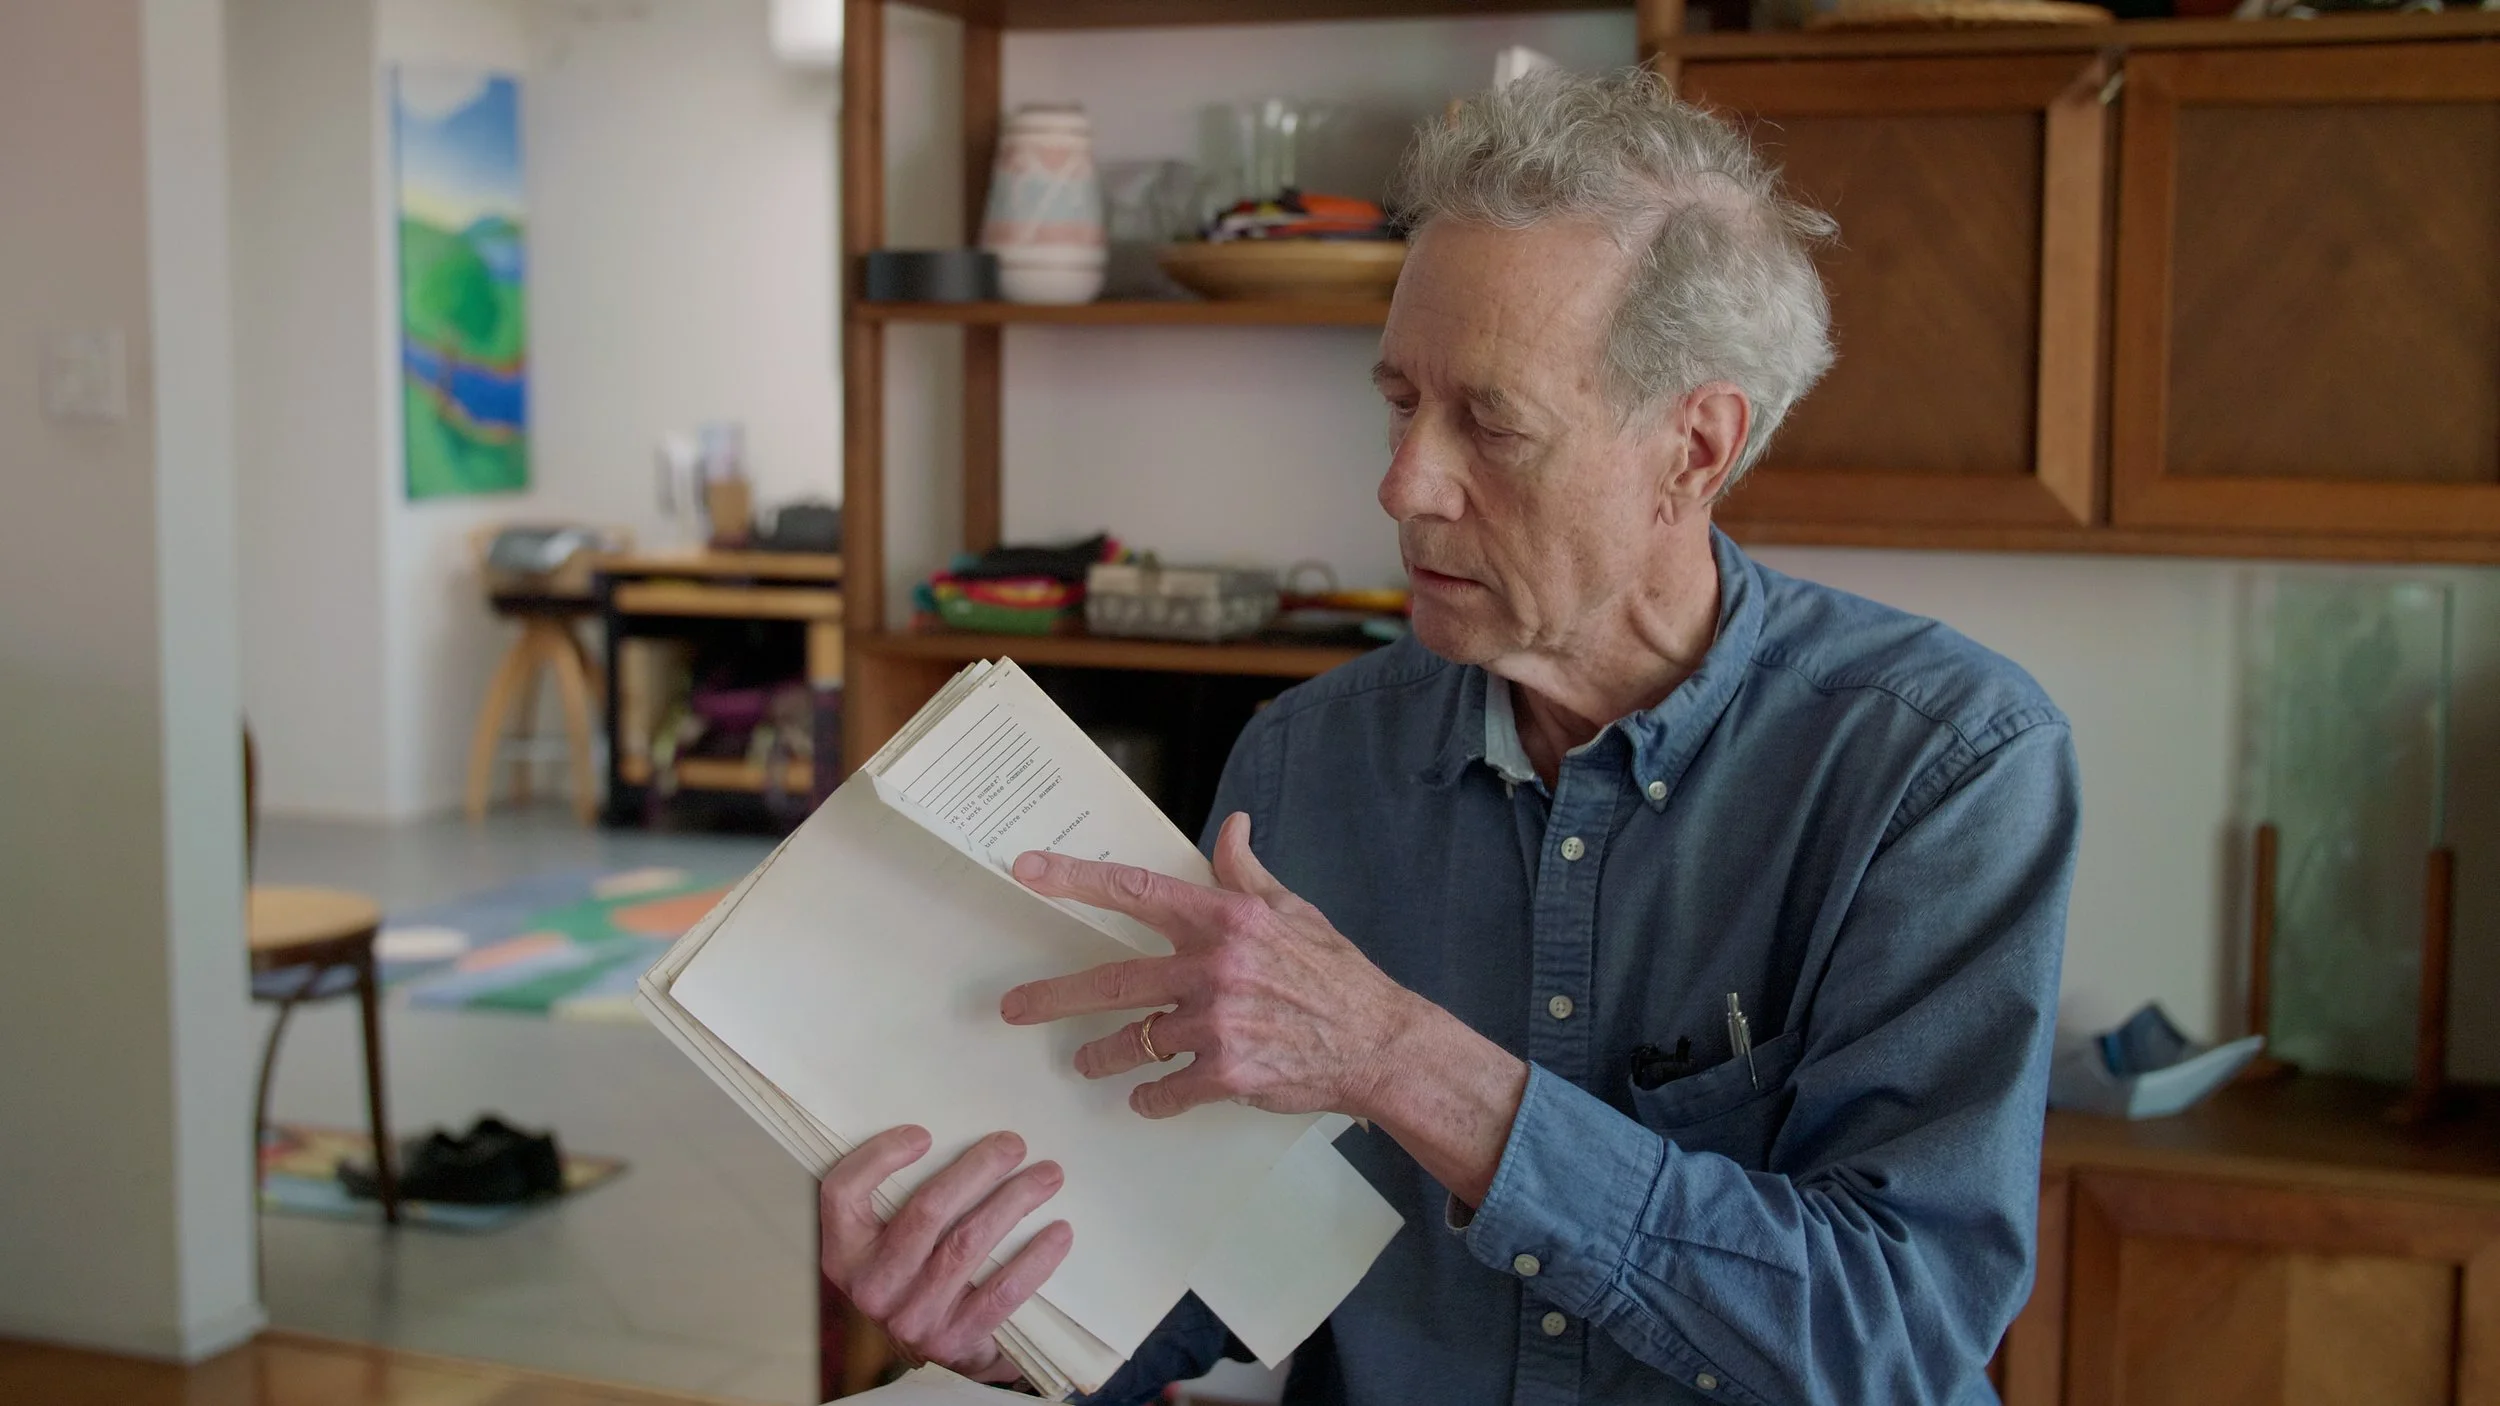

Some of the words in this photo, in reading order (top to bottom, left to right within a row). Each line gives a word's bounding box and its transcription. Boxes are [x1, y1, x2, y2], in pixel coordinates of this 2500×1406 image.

[961, 800, 976, 814] this
[977, 775, 1002, 799] summer?
[965, 806, 982, 821] work
[983, 785, 1005, 805] (these
[1006, 758, 1035, 785] comments
[998, 815, 1021, 836] before
[1021, 799, 1038, 815] this
[1039, 775, 1063, 799] summer?
[1052, 810, 1090, 845] comfortable
[1098, 850, 1111, 861] the
